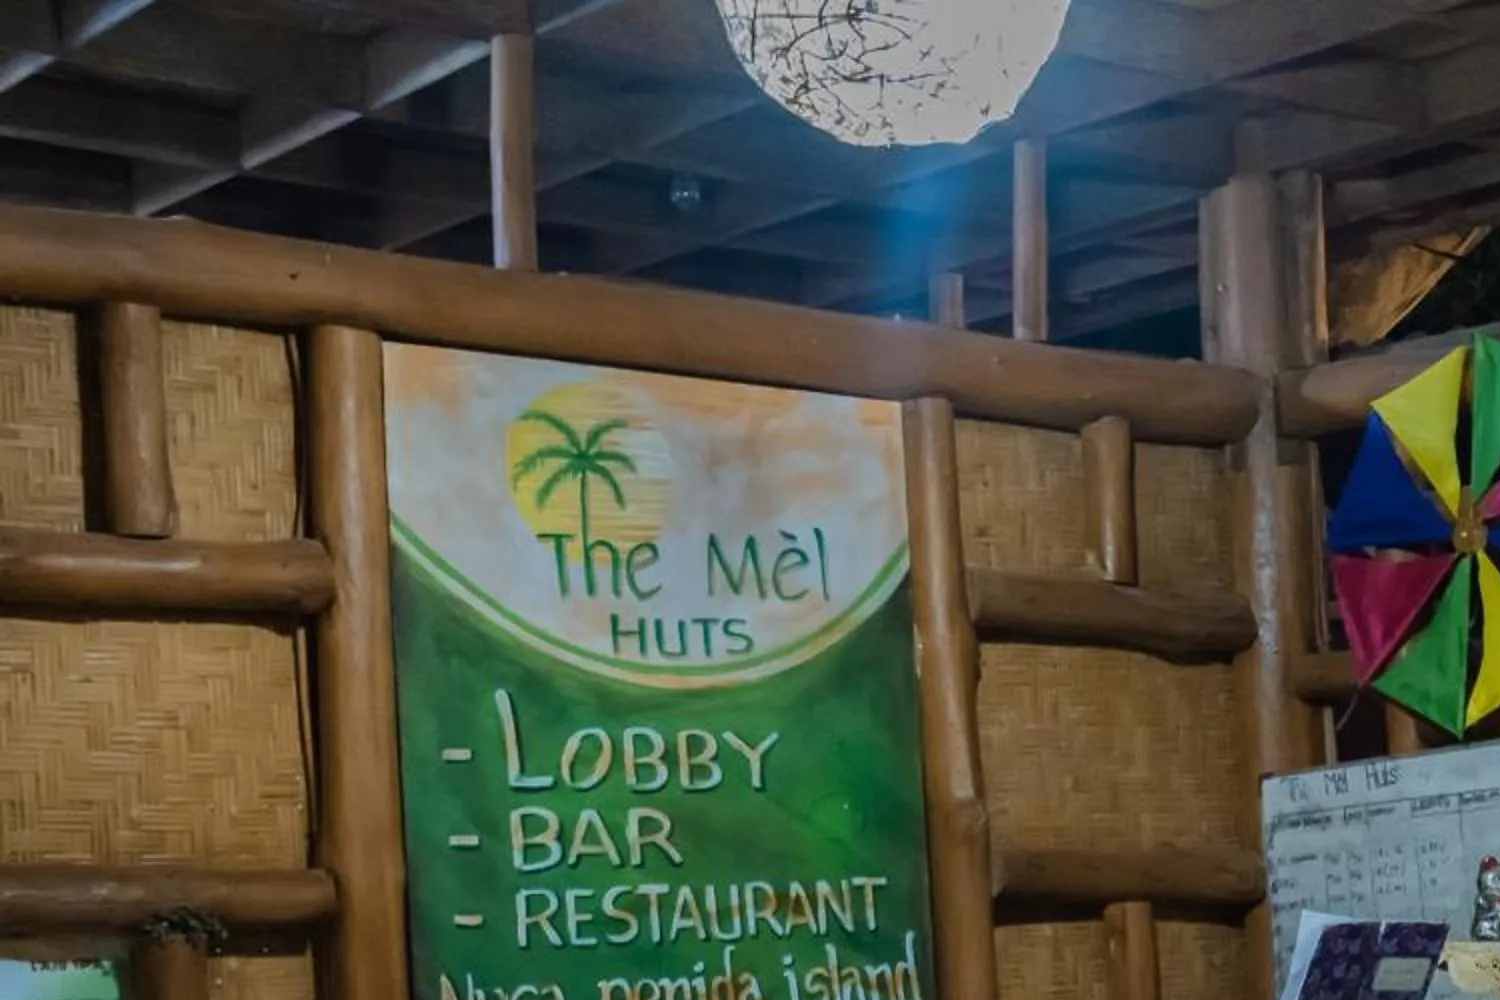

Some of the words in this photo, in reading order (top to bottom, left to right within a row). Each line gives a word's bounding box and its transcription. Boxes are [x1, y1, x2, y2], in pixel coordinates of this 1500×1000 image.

[537, 531, 664, 602] The
[707, 527, 830, 602] Mèl
[610, 613, 754, 659] HUTS
[495, 689, 780, 792] LOBBY
[510, 805, 683, 873] BAR
[515, 876, 888, 948] RESTAURANT
